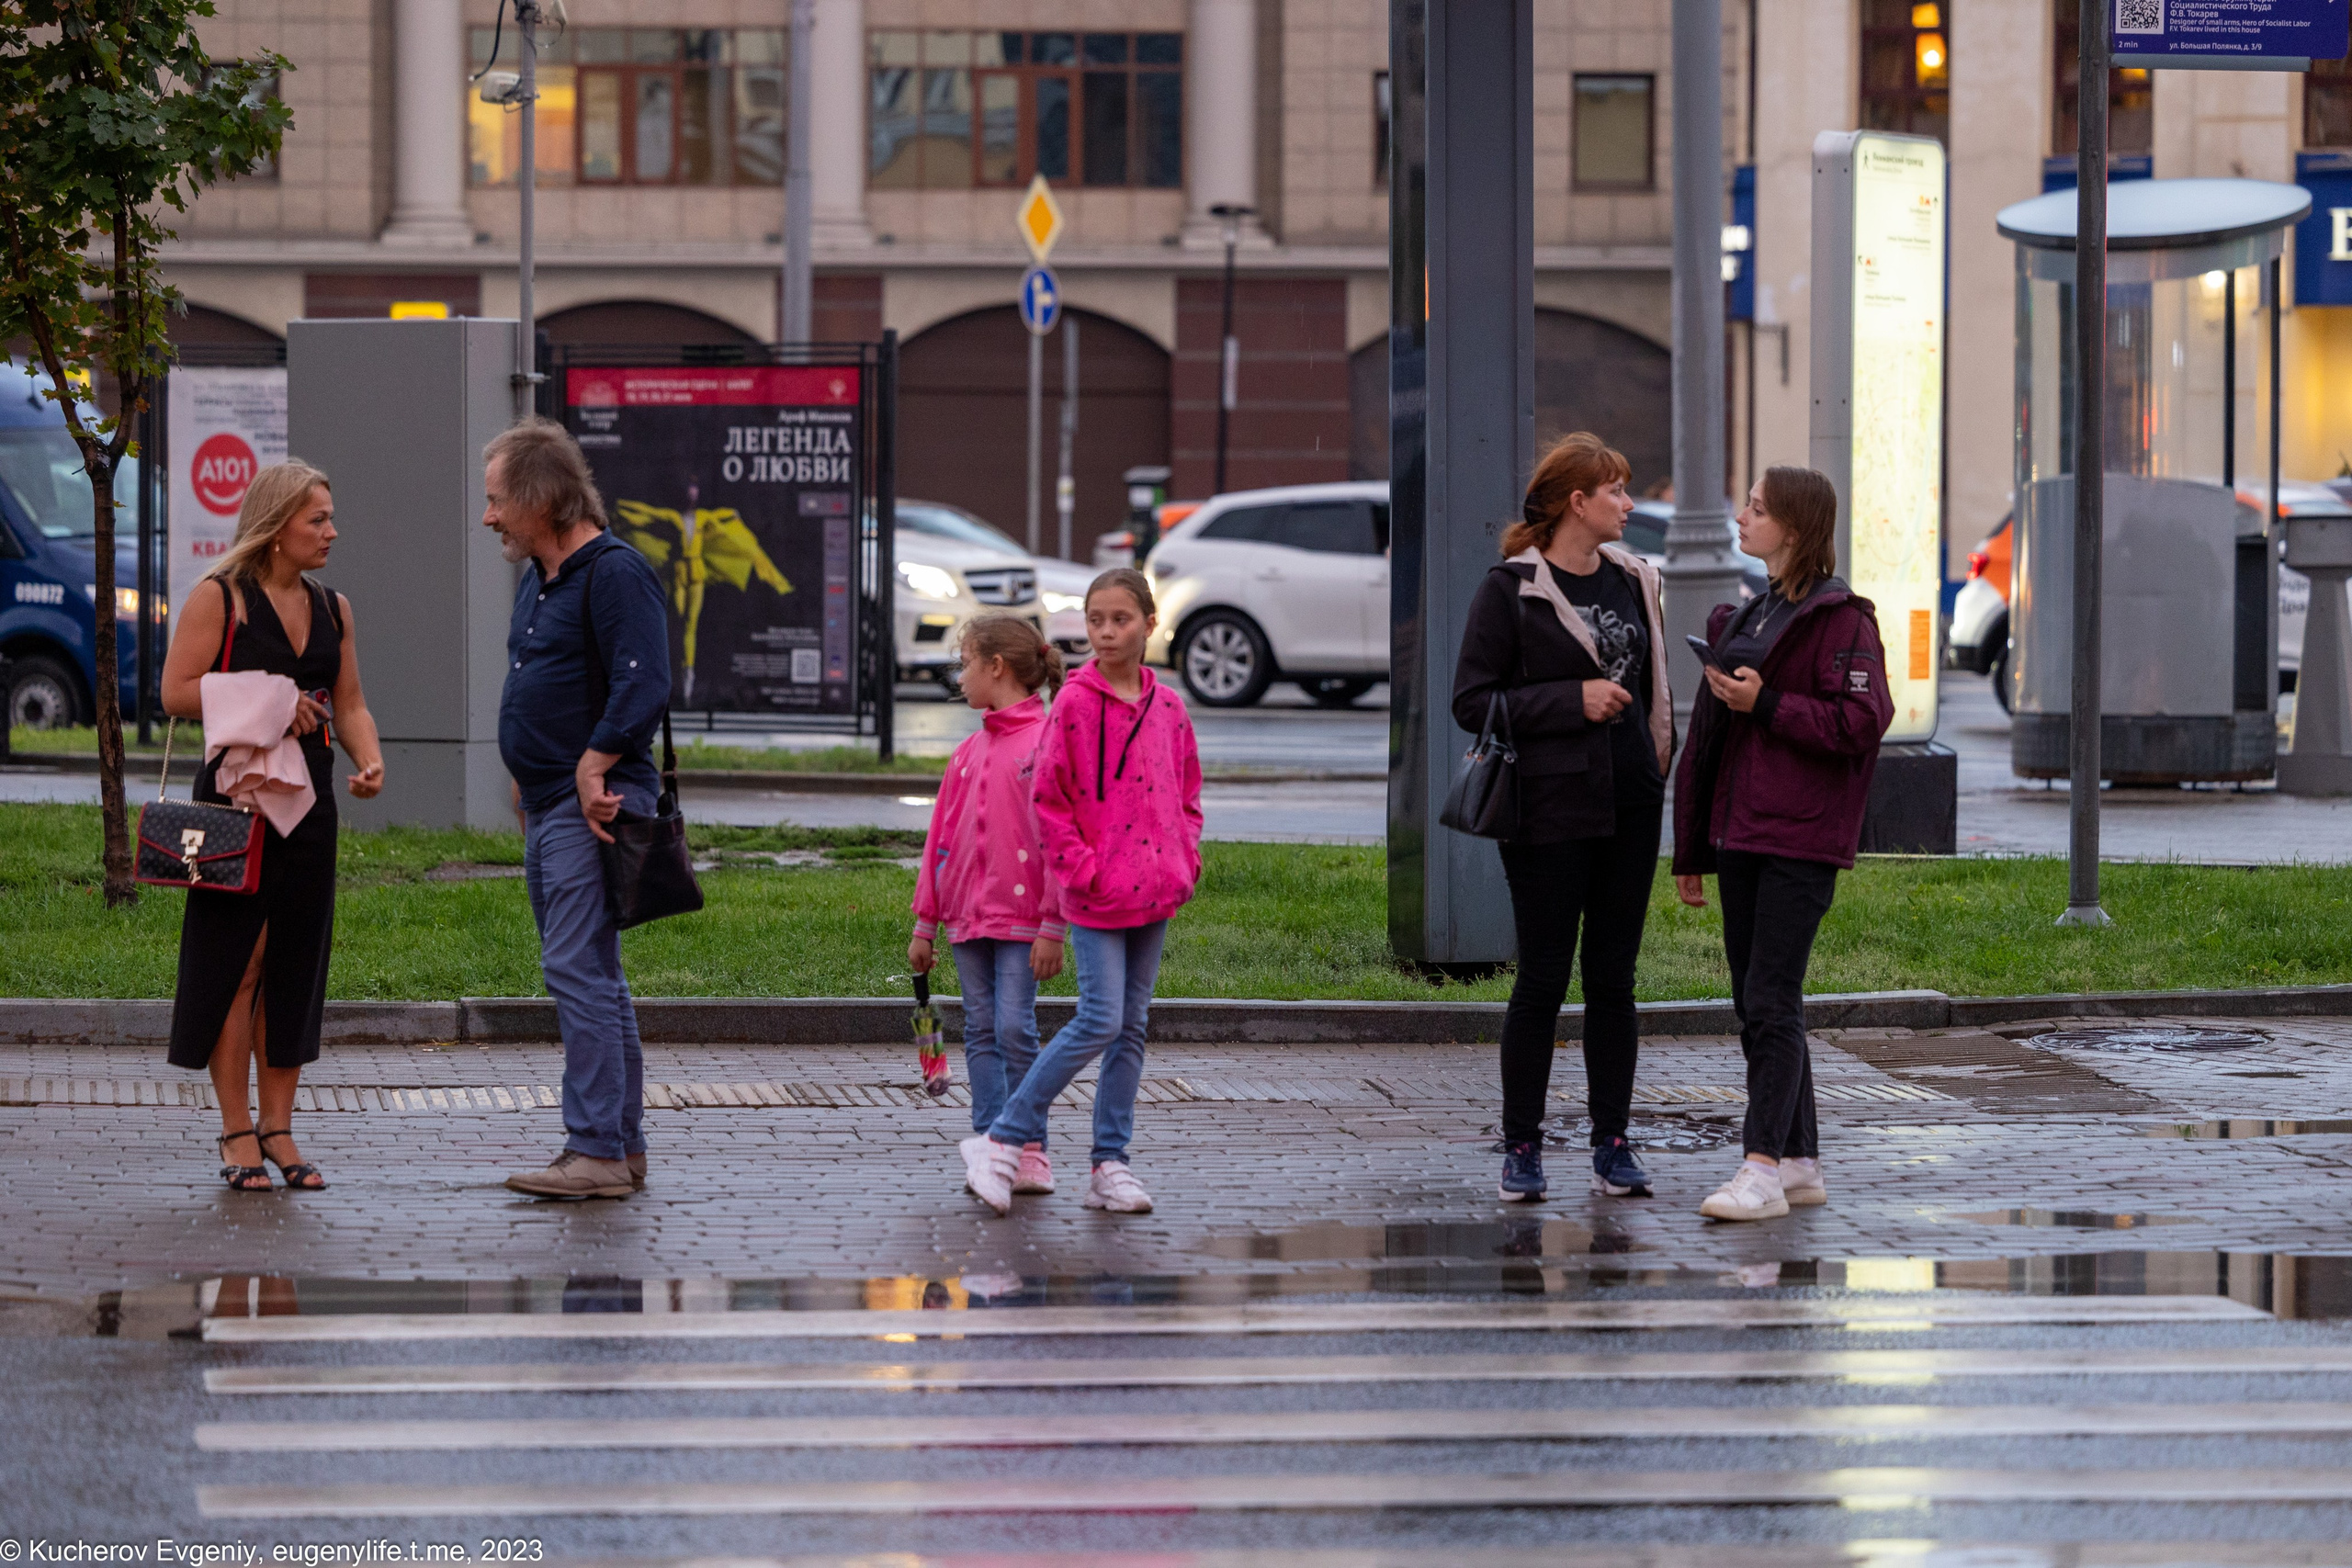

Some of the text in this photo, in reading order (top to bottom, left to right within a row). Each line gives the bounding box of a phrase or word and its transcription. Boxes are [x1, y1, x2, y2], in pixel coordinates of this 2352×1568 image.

[2170, 1, 2247, 10] Социалистического
[2249, 3, 2272, 11] Труда
[2187, 10, 2219, 18] Токарев
[2180, 41, 2211, 50] Большая
[2211, 42, 2243, 51] Полянка,
[723, 426, 854, 455] ЛЕГЕНДА
[721, 455, 852, 483] О ЛЮБВИ
